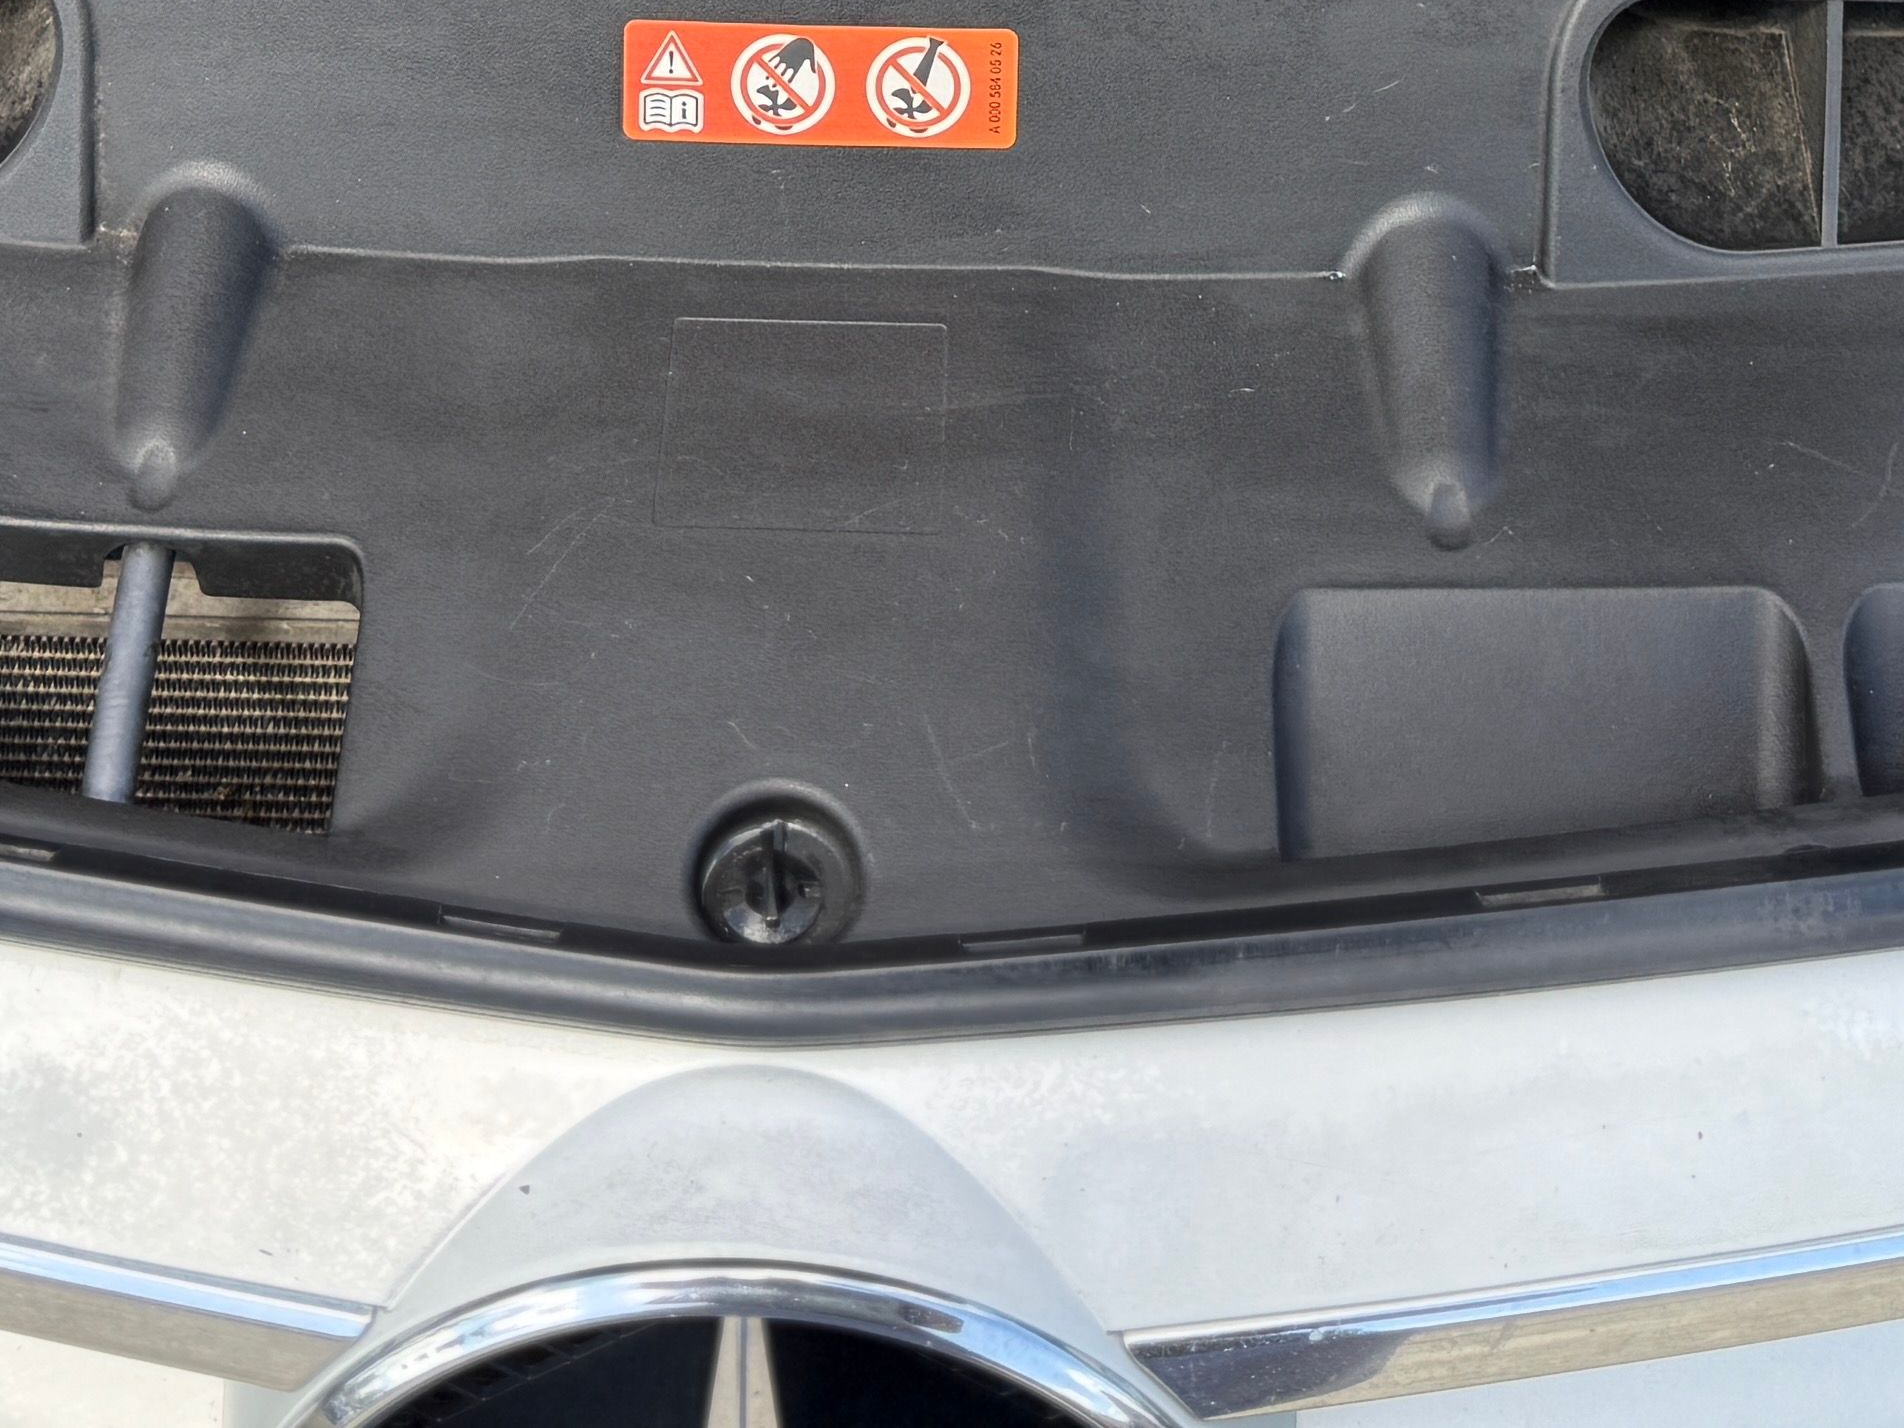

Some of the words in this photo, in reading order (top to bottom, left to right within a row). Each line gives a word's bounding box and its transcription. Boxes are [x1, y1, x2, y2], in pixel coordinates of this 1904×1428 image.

[990, 42, 1002, 56] 26
[989, 59, 1002, 74] 05
[989, 77, 1002, 98] 584
[988, 101, 1001, 123] 000
[988, 125, 1001, 134] A
